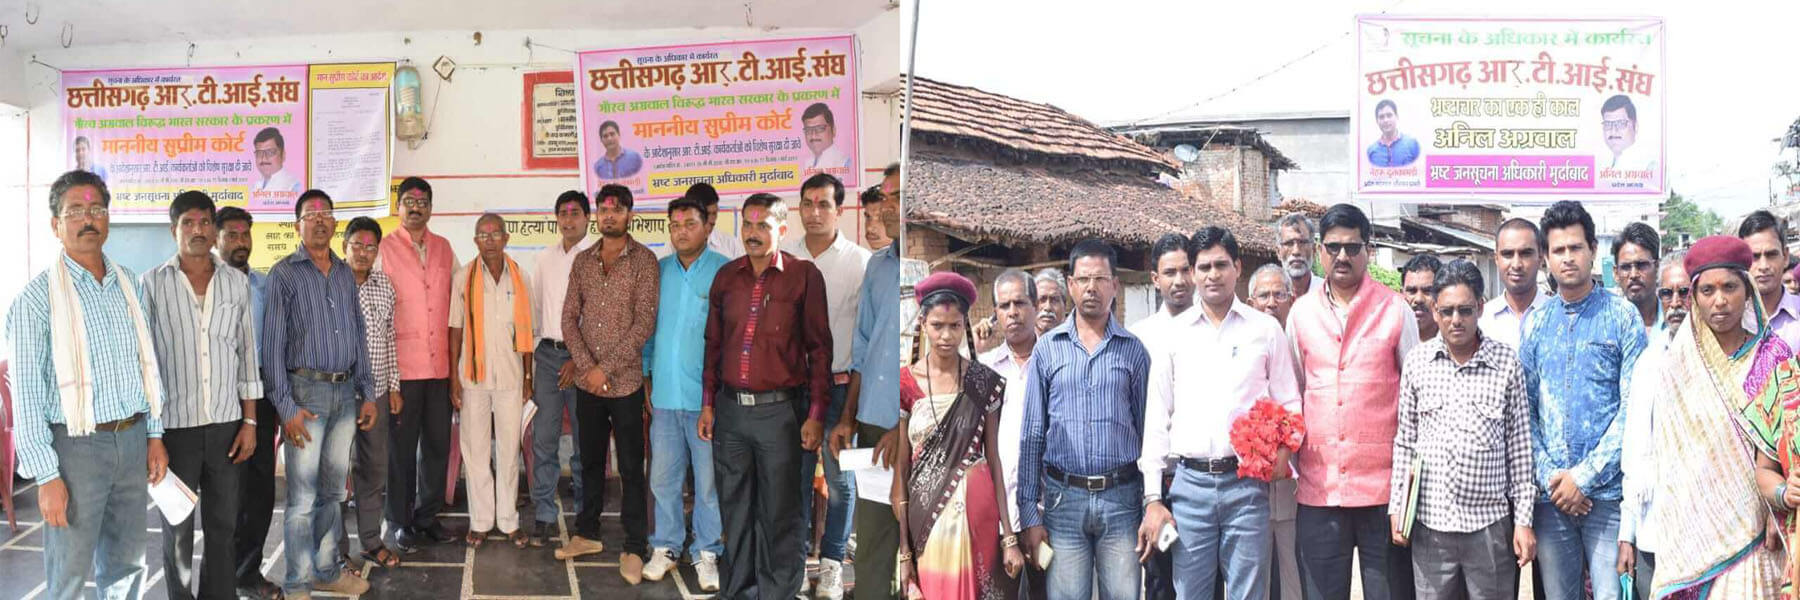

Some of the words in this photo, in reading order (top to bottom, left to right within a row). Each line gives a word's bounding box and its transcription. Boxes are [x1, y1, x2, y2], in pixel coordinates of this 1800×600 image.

[1400, 31, 1451, 48] सूचना
[1458, 29, 1478, 45] के
[1484, 27, 1557, 46] अधिकार
[589, 58, 686, 92] छत्तीसगढ़
[1365, 57, 1472, 95] छत्तीसगढ़
[67, 79, 150, 111] छत्तीसगढ़
[708, 95, 735, 106] भारत
[739, 93, 774, 104] सरकार
[776, 89, 788, 102] के
[1484, 97, 1502, 116] का
[1549, 97, 1581, 117] काल
[232, 112, 243, 125] के
[632, 115, 699, 138] माननीय
[702, 111, 751, 139] सुप्रीम
[754, 107, 792, 131] कोर्ट
[102, 133, 159, 154] माननीय
[162, 132, 207, 158] सुप्रीम
[210, 130, 247, 152] कोर्ट
[1433, 120, 1496, 148] अनिल
[1498, 129, 1577, 149] अग्रवाल
[716, 170, 756, 185] अधिकारी
[1430, 164, 1451, 182] भ्रष्ट
[1453, 164, 1499, 186] जनसूचना
[1502, 159, 1547, 182] अधिकारी
[521, 220, 545, 236] हत्या
